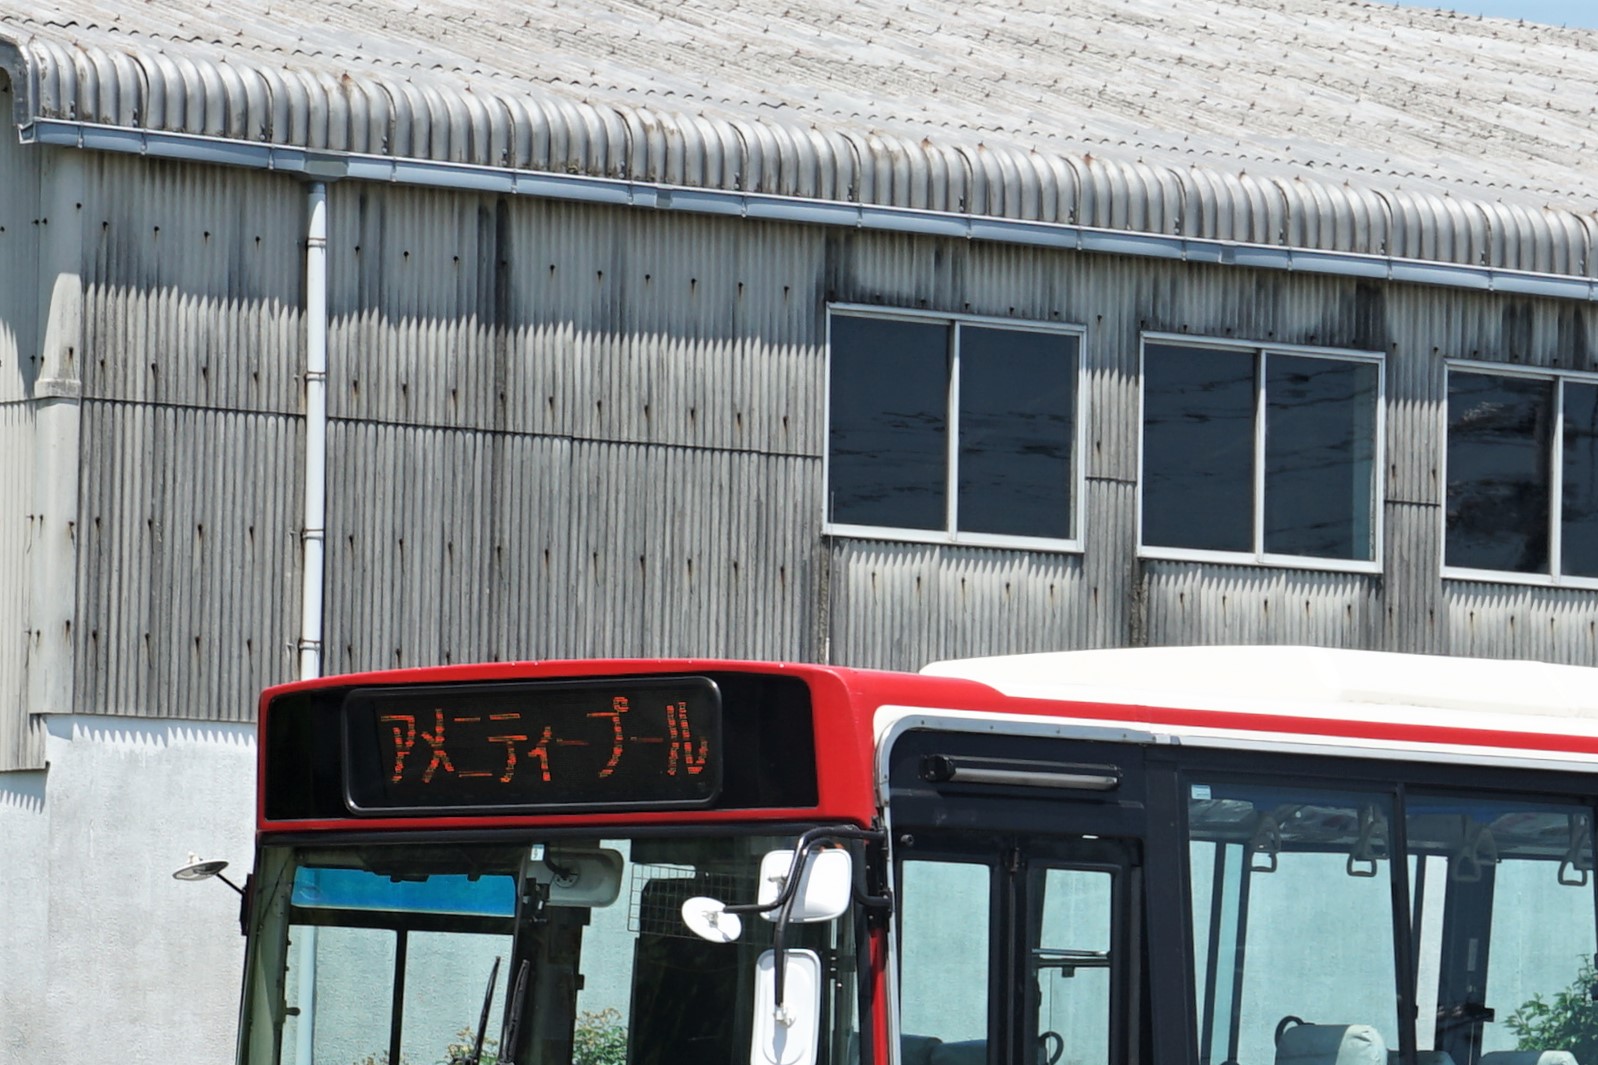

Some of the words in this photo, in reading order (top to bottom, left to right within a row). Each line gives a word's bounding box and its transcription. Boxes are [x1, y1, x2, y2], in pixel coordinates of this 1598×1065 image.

[380, 696, 709, 784] アメニティープール
